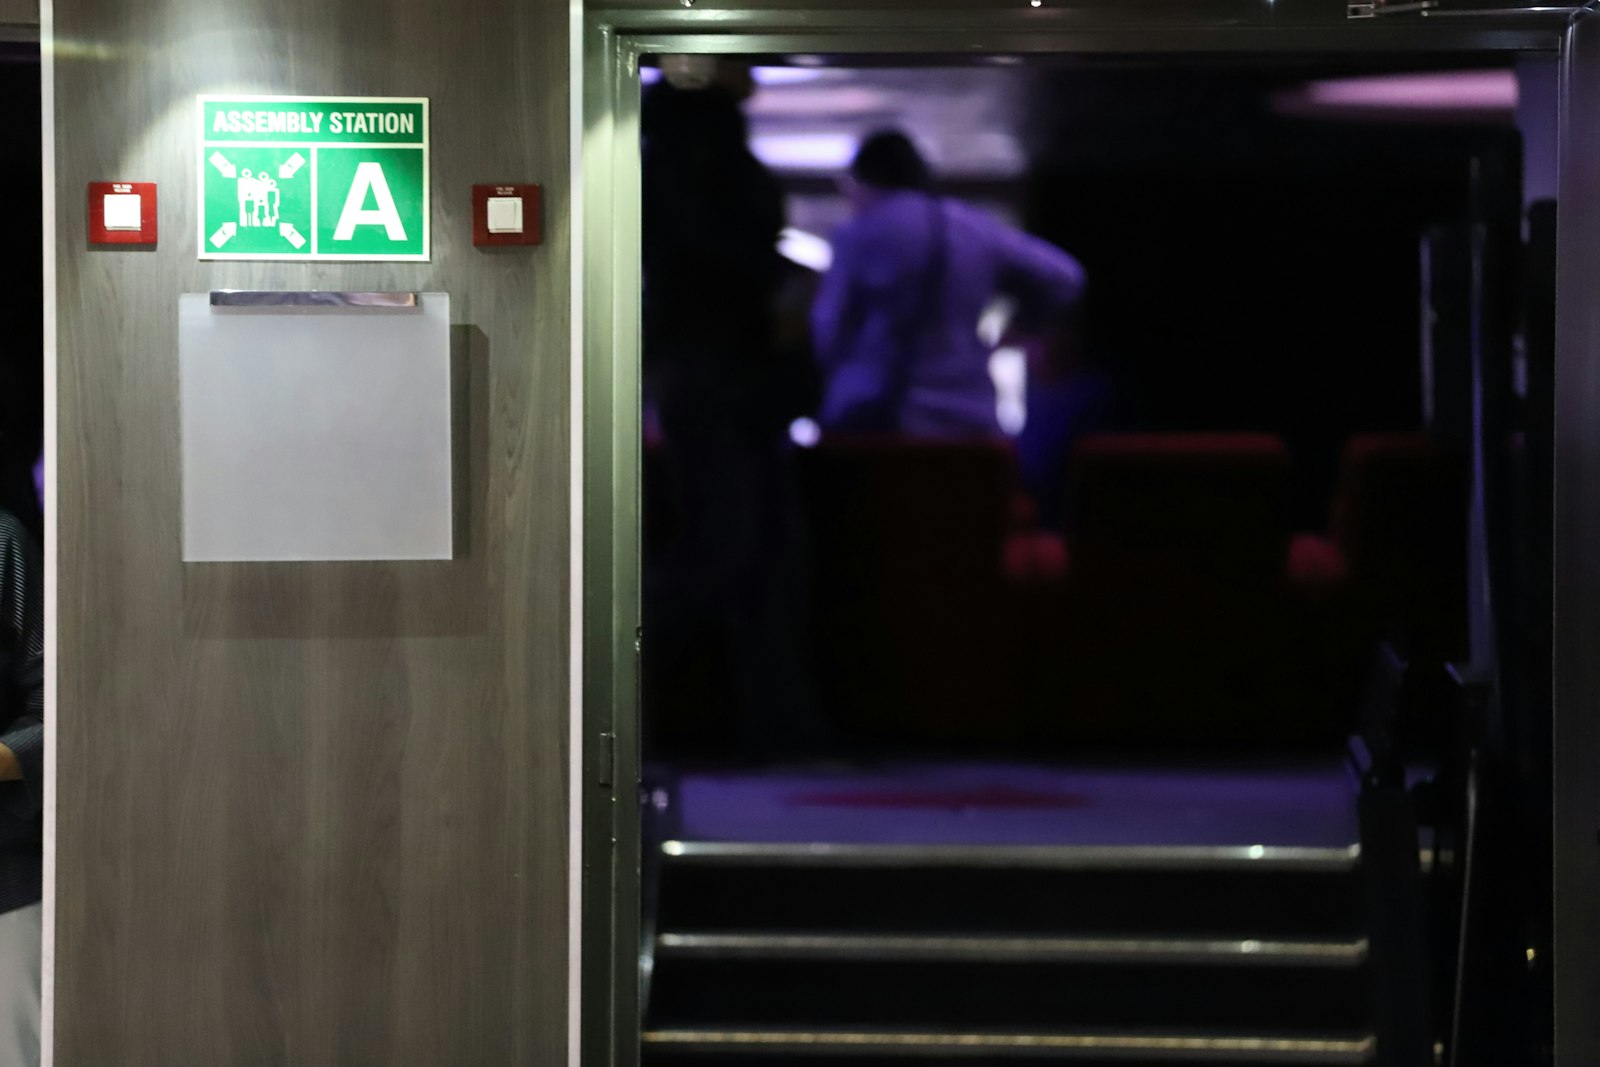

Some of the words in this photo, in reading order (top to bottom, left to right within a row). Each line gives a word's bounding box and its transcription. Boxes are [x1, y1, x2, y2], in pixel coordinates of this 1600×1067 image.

[213, 110, 323, 134] ASSEMBLY
[329, 111, 414, 134] STATION
[333, 162, 408, 241] A
